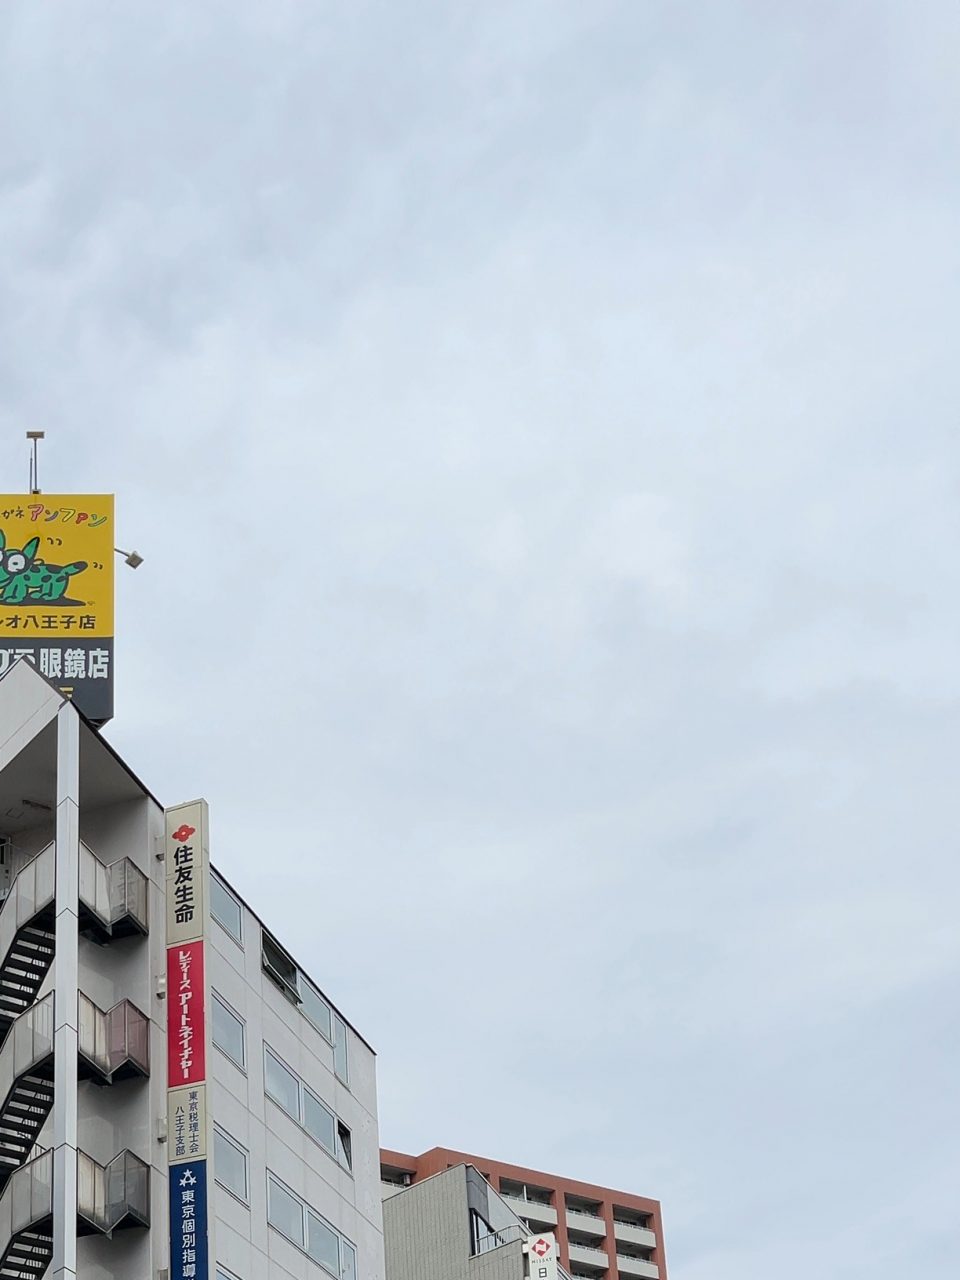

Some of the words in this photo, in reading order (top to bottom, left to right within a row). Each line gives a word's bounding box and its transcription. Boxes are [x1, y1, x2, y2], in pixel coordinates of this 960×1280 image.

[28, 503, 107, 528] アンファン
[173, 845, 194, 924] 住友生命
[175, 1106, 186, 1155] 八王子支部
[189, 1092, 199, 1153] 東京税理士会
